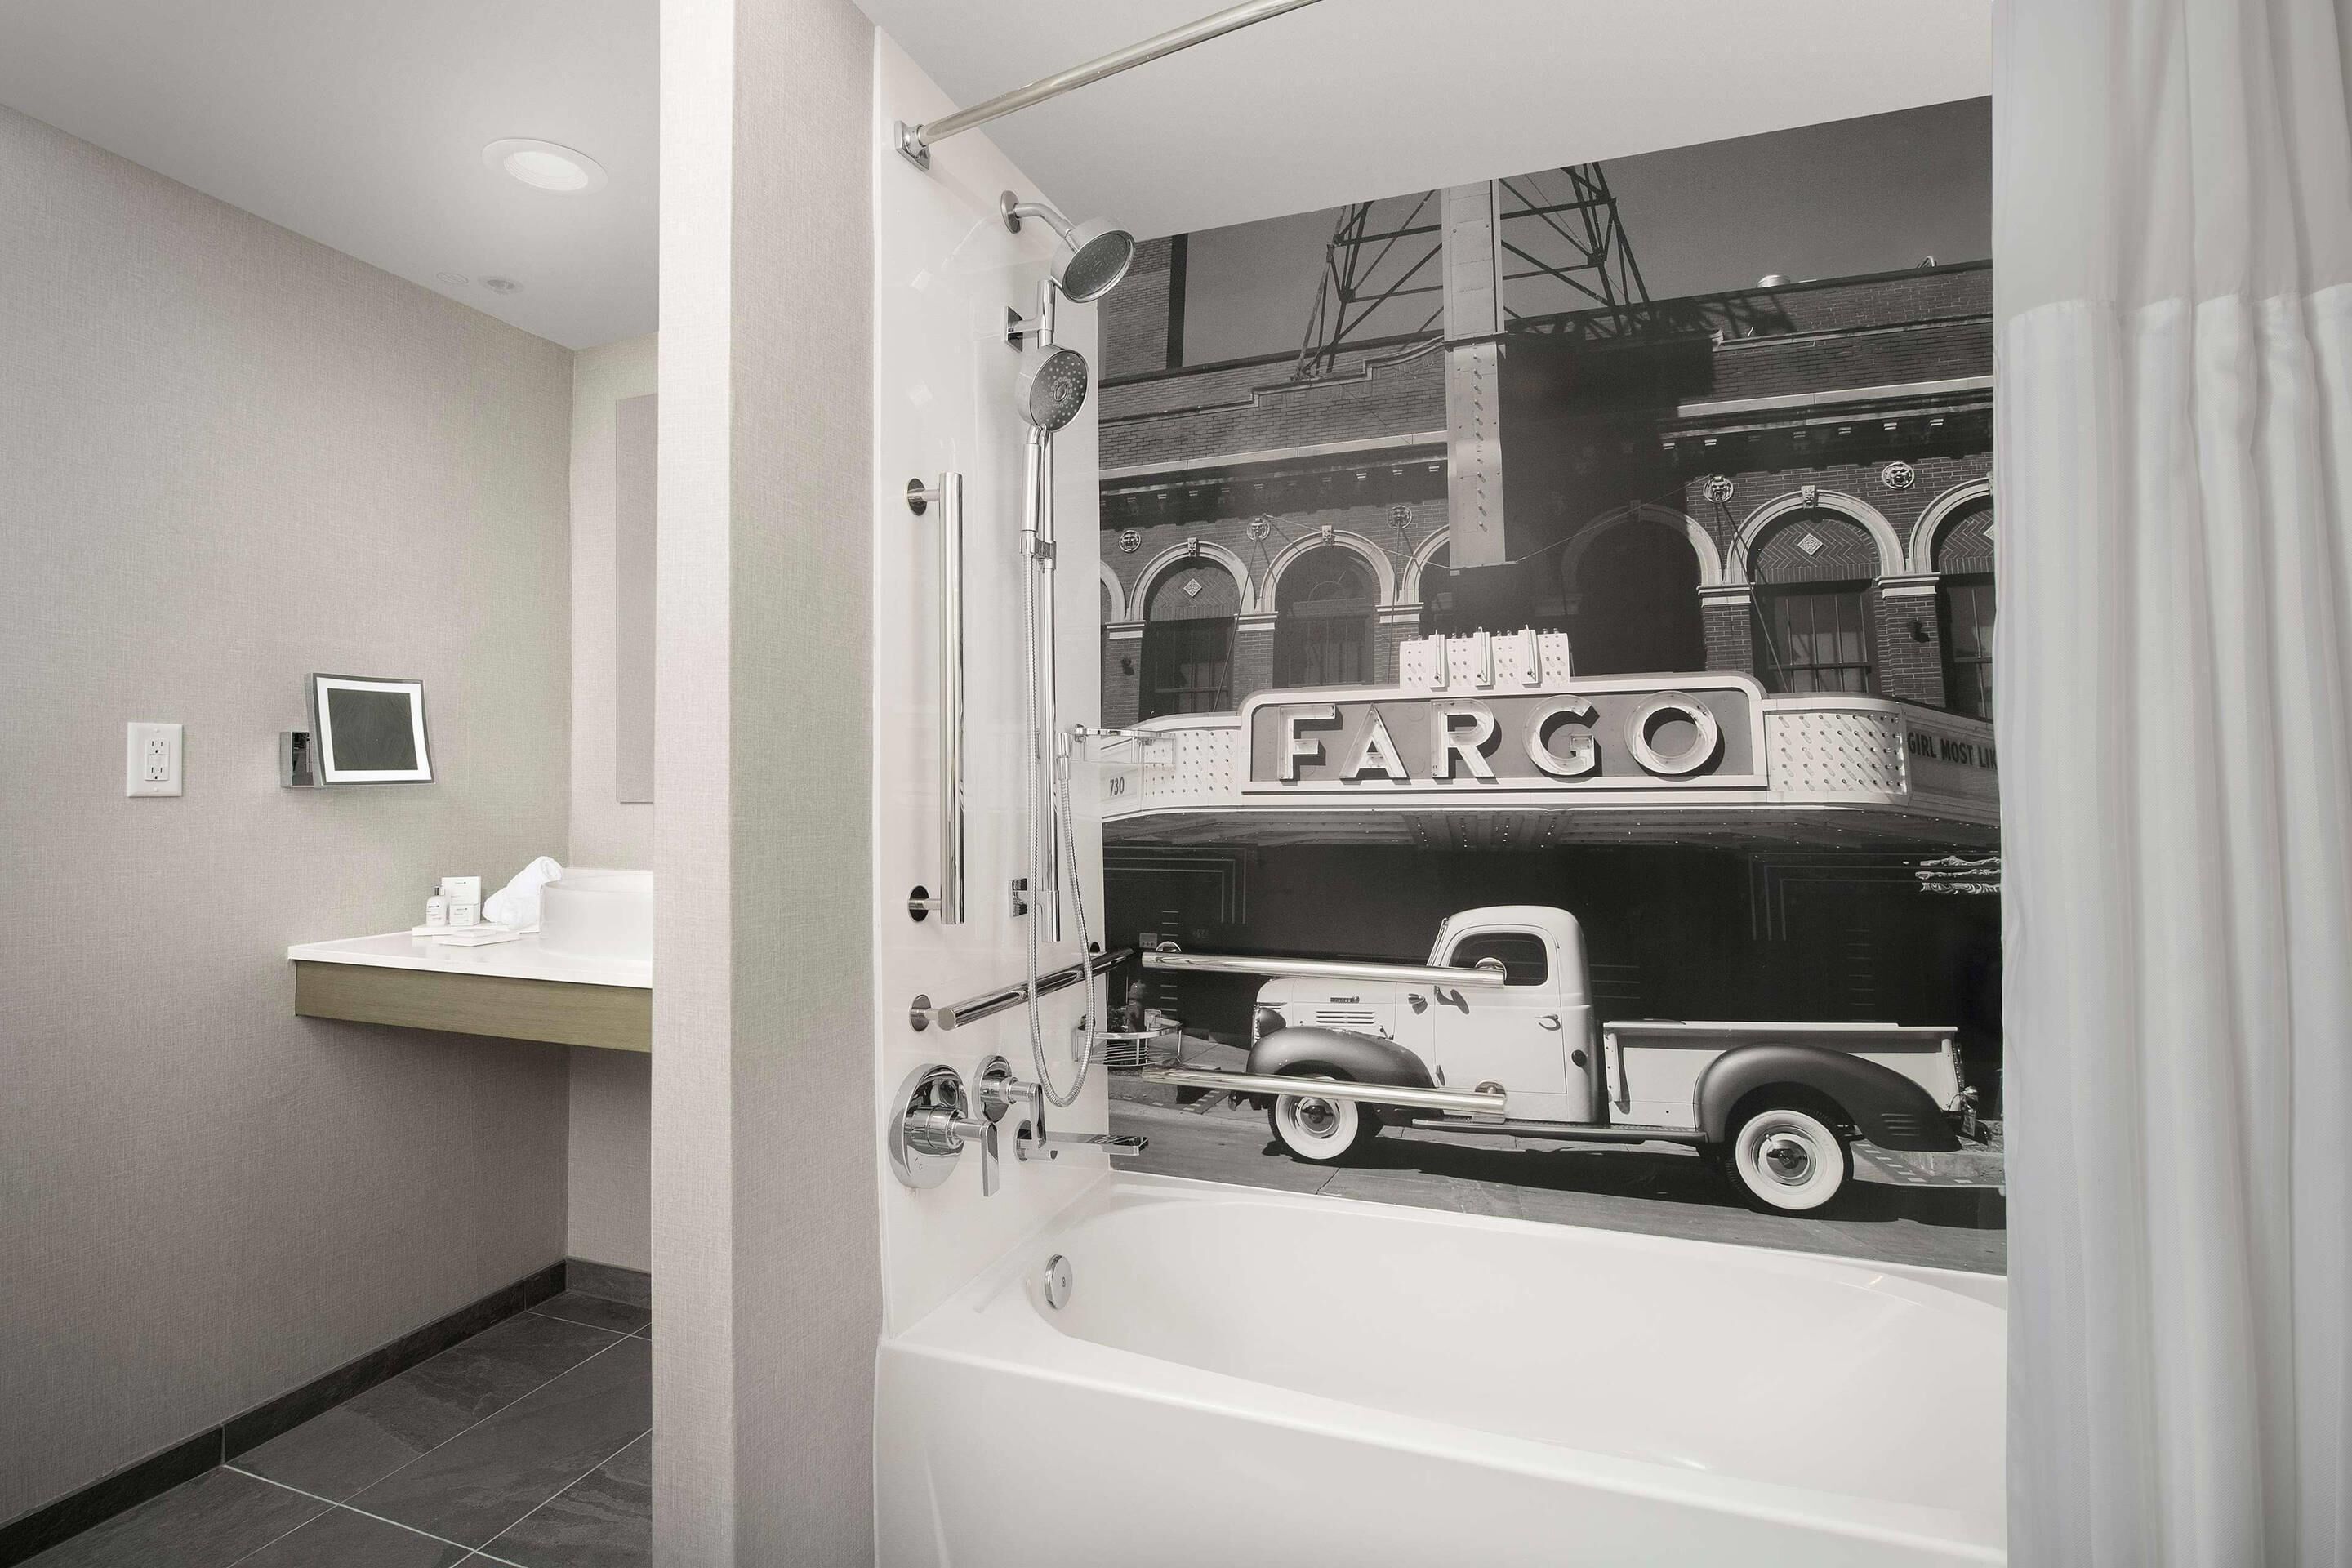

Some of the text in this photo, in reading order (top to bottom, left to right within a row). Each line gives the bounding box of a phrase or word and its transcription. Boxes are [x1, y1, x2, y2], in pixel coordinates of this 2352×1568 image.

[1277, 691, 1717, 780] FARGO
[1907, 732, 1936, 758] GIRL
[1940, 738, 1973, 765] MOST
[1110, 777, 1125, 796] 730
